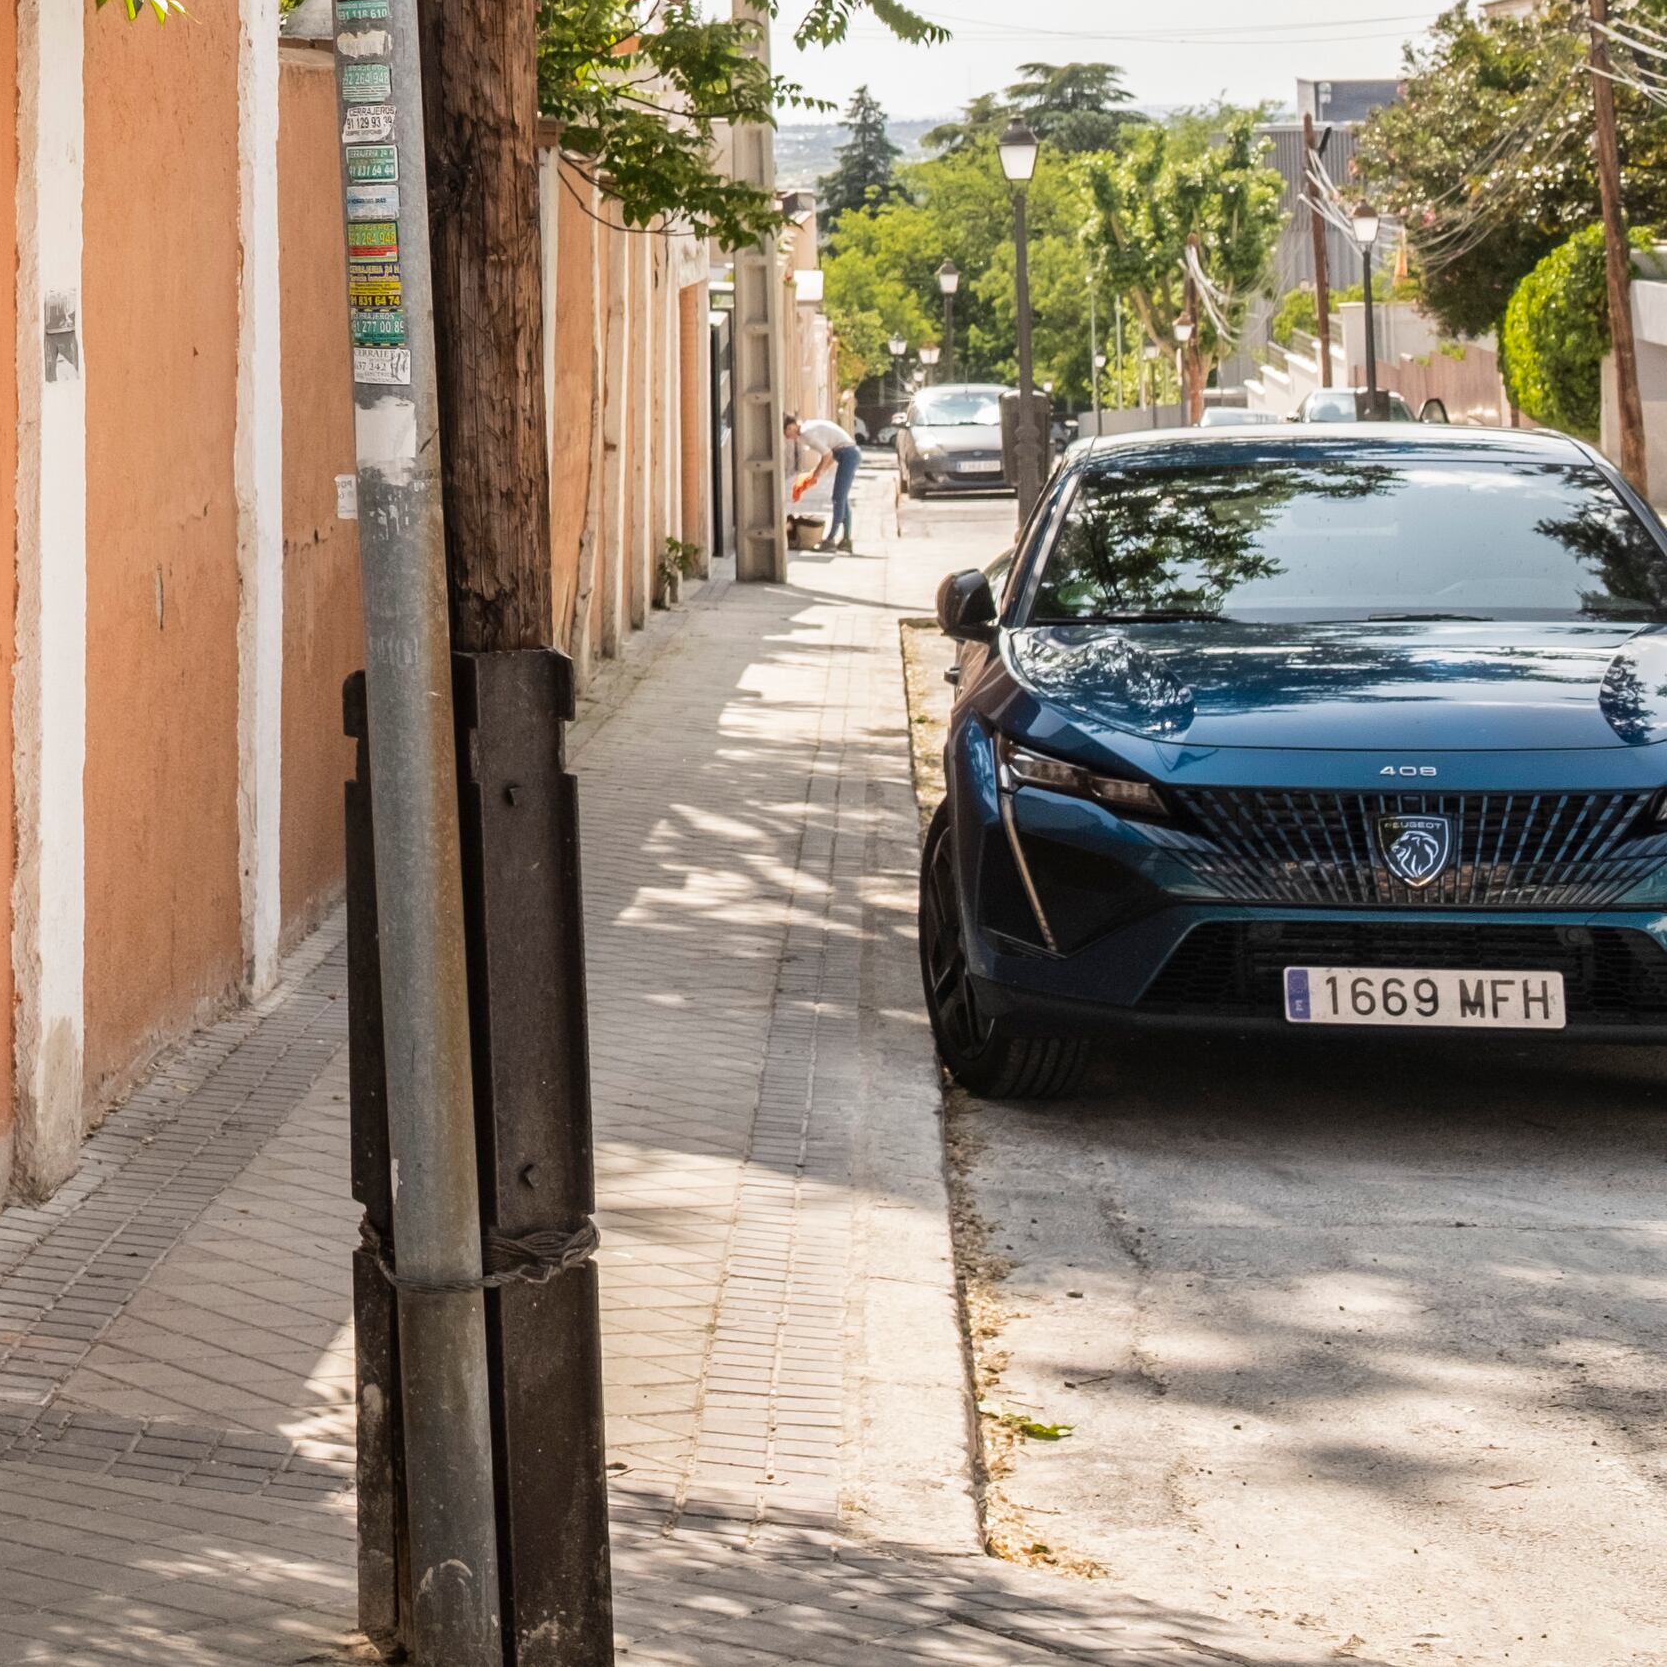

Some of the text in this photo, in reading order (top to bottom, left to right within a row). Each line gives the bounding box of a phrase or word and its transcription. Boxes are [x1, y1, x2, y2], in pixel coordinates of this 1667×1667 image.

[370, 7, 388, 19] 610
[347, 118, 354, 130] 91
[357, 117, 369, 129] 129
[371, 116, 381, 128] 93
[388, 296, 400, 306] 74
[362, 321, 376, 333] 277
[380, 320, 391, 333] 00
[1380, 765, 1437, 776] 408
[1384, 821, 1442, 829] PEUGEOT
[1325, 976, 1439, 1017] 1669
[1459, 979, 1550, 1019] MFH
